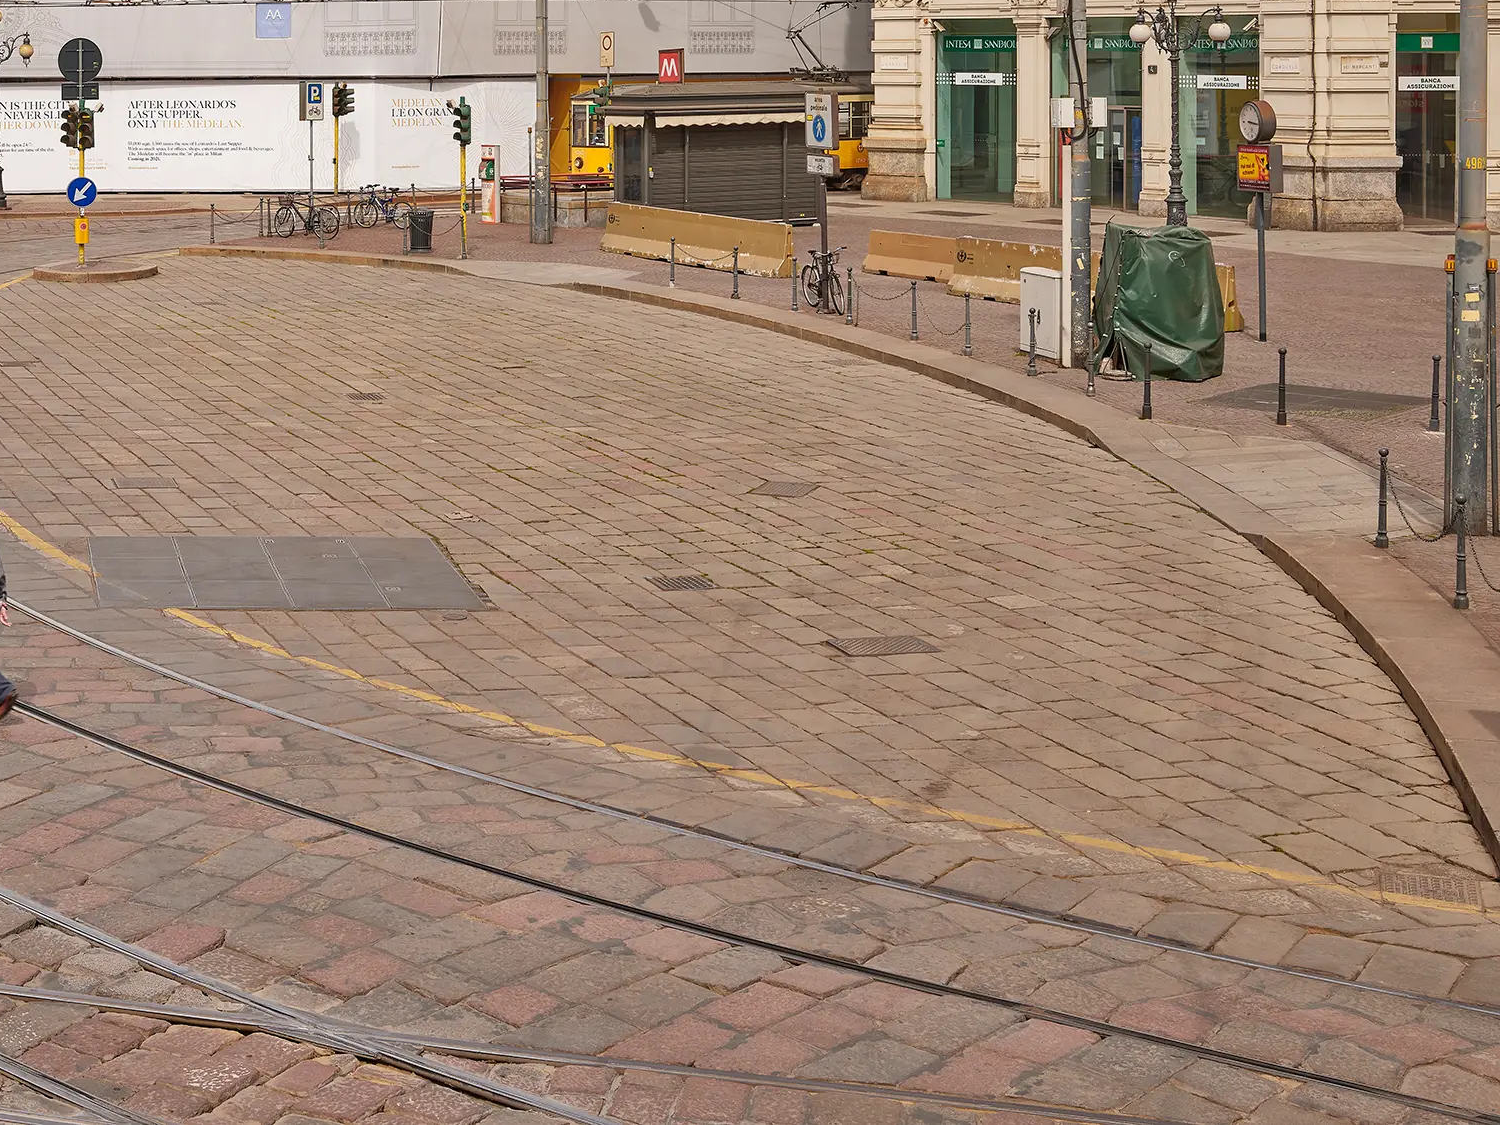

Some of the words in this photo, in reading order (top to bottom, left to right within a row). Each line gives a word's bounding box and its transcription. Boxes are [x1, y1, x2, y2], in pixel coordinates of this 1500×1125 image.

[946, 39, 971, 49] INTESA
[660, 58, 678, 77] M
[9, 102, 20, 111] IS
[21, 101, 46, 110] THE
[127, 100, 164, 109] AFTER
[166, 100, 237, 110] LEONARDO'S
[4, 111, 41, 120] NEVER
[127, 110, 156, 119] LAST
[407, 108, 422, 116] ON
[25, 121, 41, 130] DO
[127, 120, 159, 129] ONLY
[162, 120, 184, 129] THE
